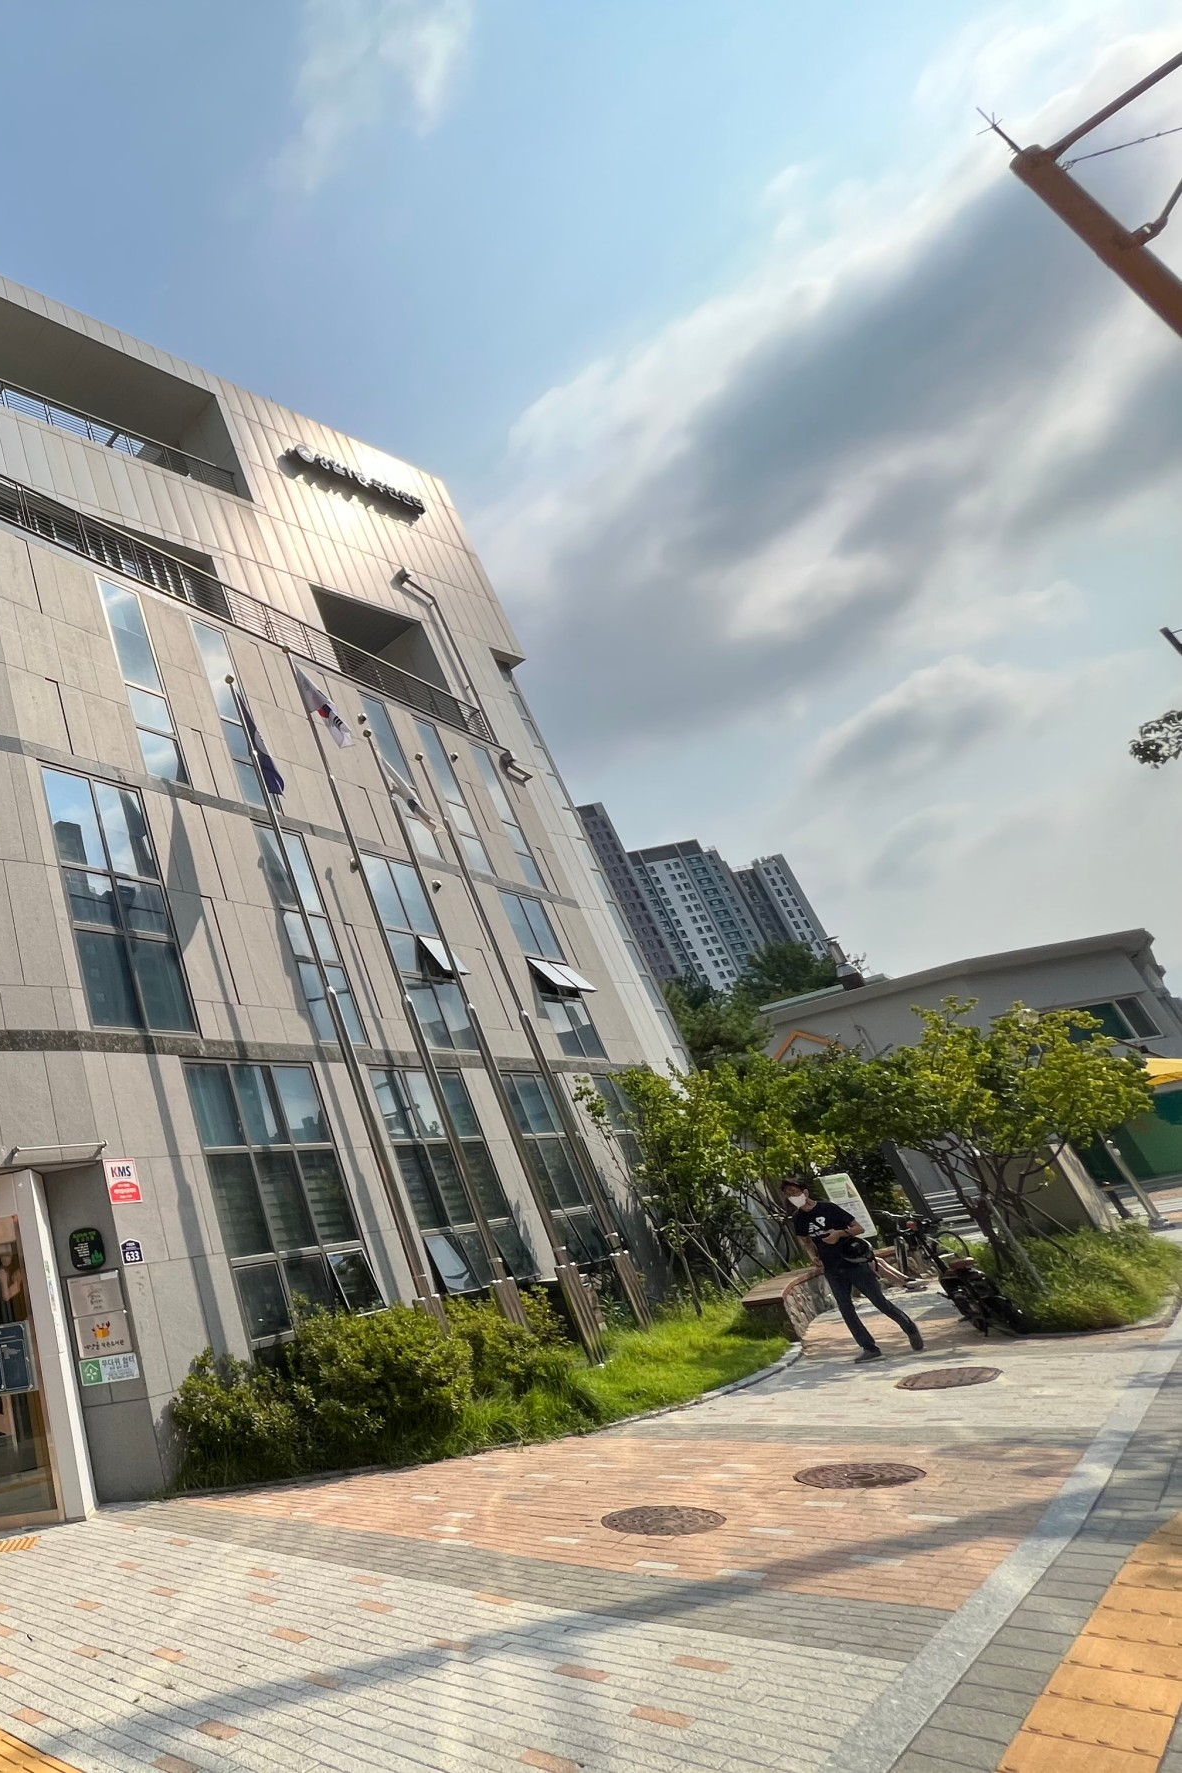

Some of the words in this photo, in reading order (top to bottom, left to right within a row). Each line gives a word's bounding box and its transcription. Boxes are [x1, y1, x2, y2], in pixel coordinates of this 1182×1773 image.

[111, 1166, 131, 1177] KMS
[125, 1251, 140, 1261] 633
[102, 1358, 121, 1368] 무더위
[122, 1355, 136, 1364] 쉼터
